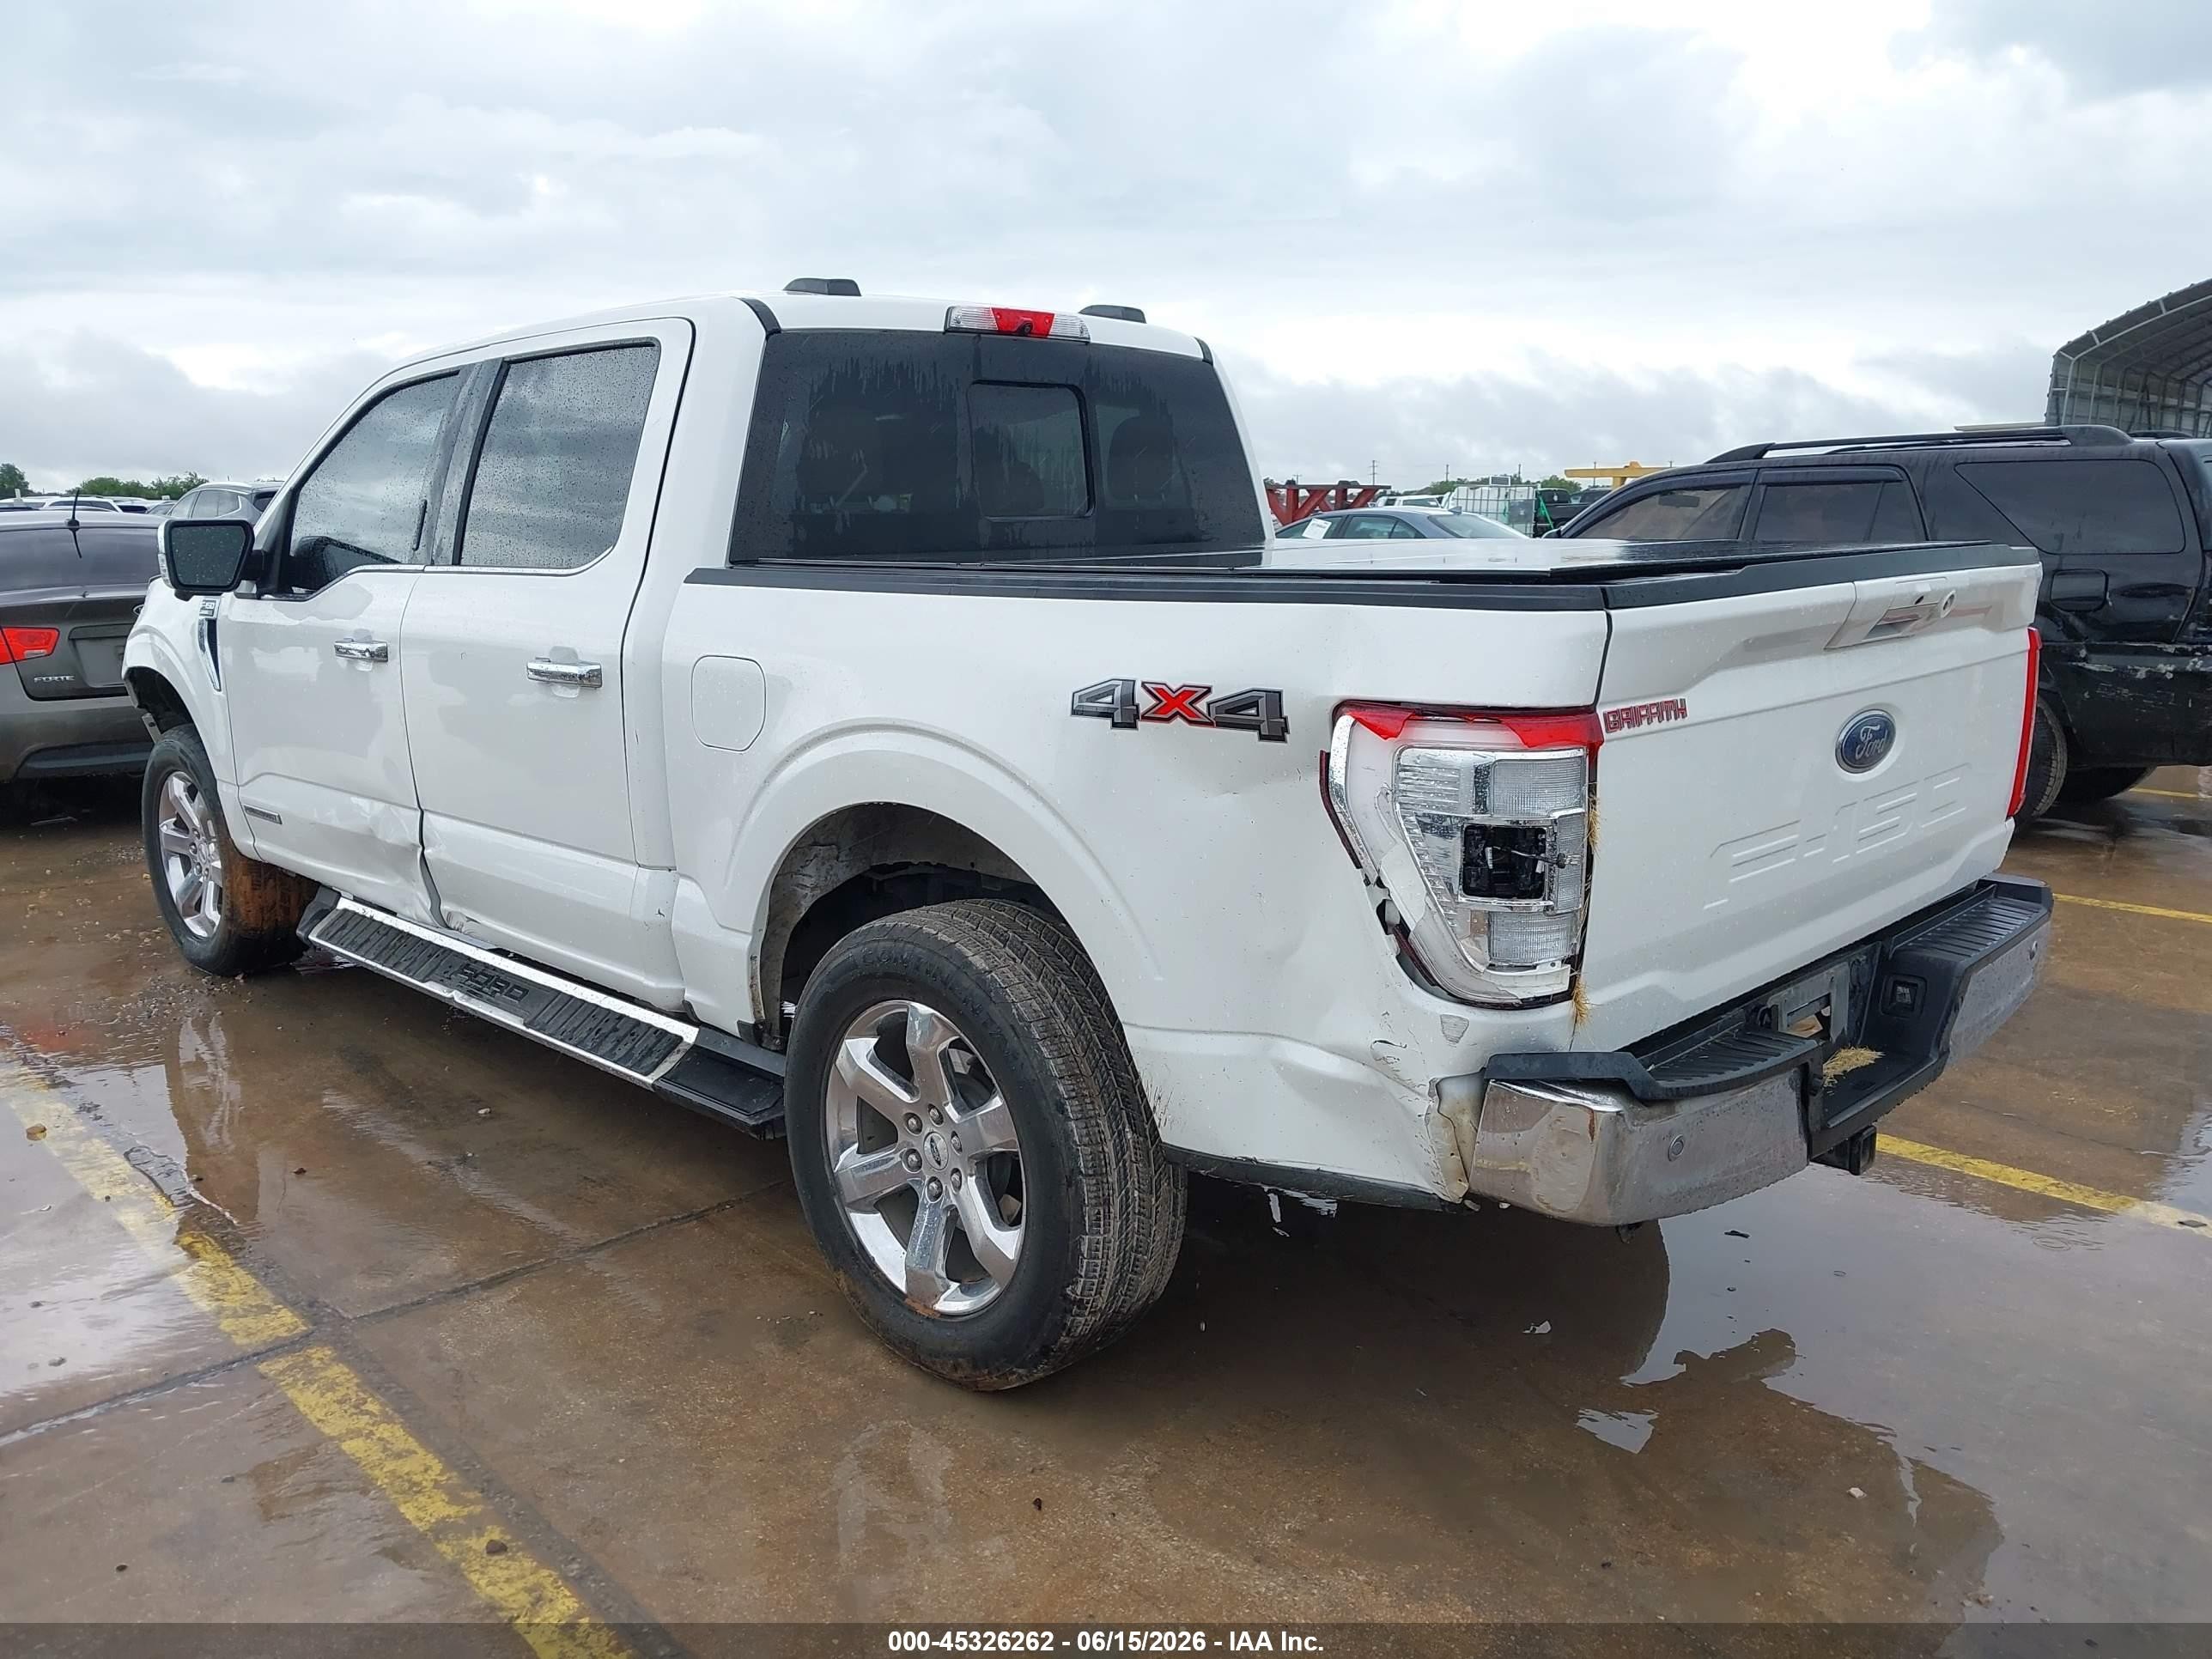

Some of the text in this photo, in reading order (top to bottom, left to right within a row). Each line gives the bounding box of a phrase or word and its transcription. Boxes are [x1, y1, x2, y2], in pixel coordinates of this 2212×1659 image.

[34, 675, 76, 684] FORTE
[1603, 698, 1688, 734] GRIFFITH
[1855, 724, 1889, 761] Ford
[449, 963, 530, 1003] FORD
